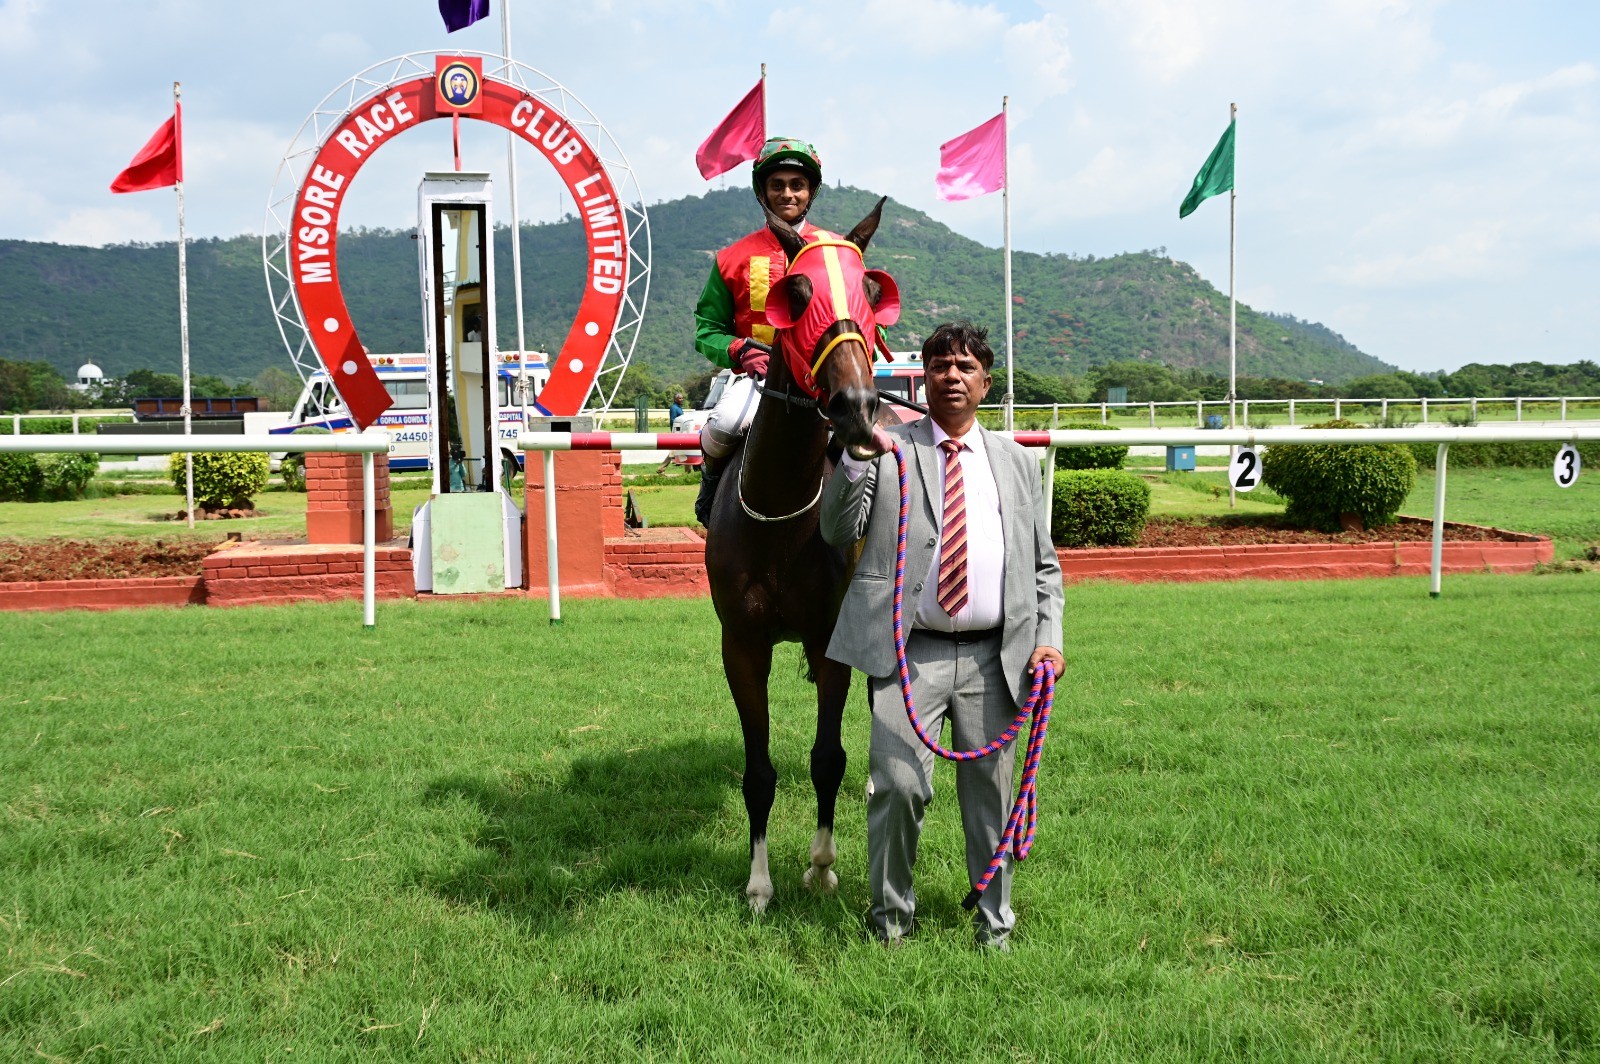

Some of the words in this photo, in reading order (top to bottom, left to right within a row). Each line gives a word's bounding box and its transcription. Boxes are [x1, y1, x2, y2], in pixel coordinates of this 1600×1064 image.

[297, 163, 346, 284] MYSORE
[335, 91, 414, 159] RACE
[510, 99, 583, 166] CLUB
[574, 172, 623, 295] LIMITED
[380, 416, 403, 424] GOPALA
[403, 415, 424, 424] GOWDA
[498, 412, 522, 421] OSPITAL
[1235, 451, 1256, 487] 2
[1559, 450, 1575, 485] 3
